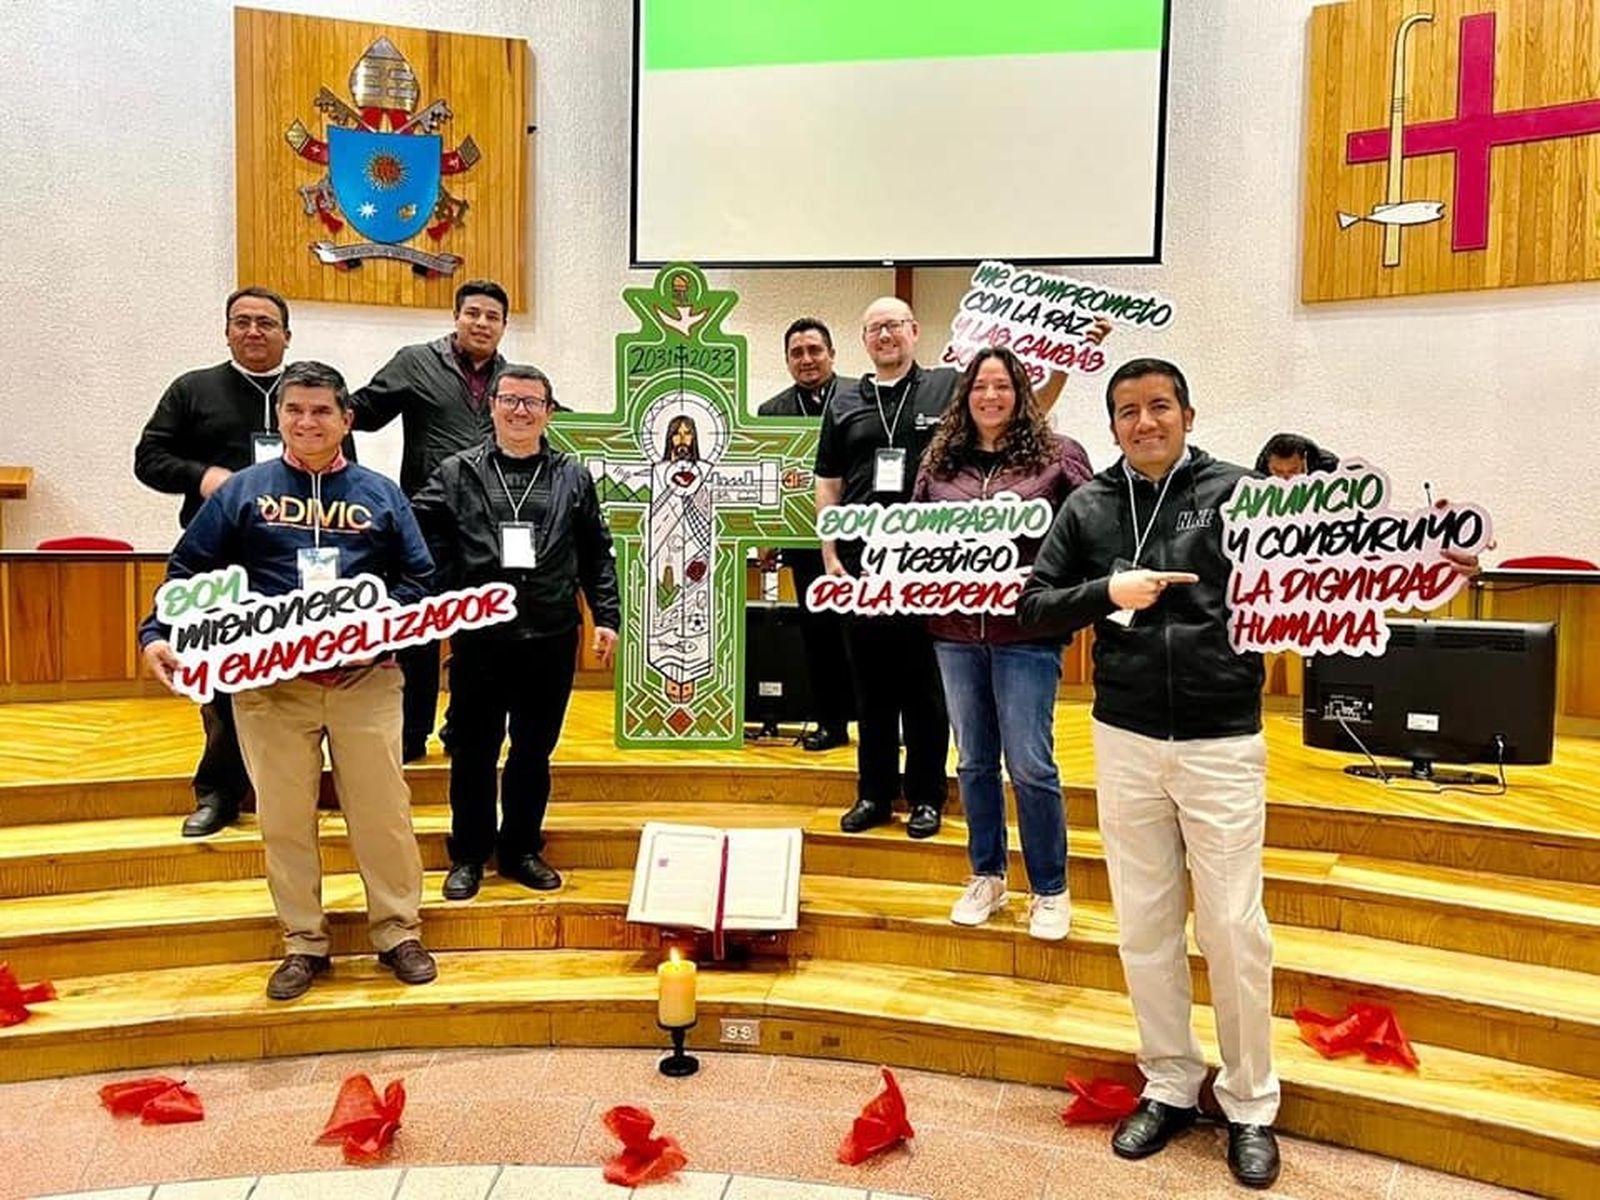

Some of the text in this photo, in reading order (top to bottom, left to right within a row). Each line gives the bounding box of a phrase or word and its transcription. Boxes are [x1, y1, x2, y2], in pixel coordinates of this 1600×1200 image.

[964, 291, 1009, 317] CON
[1010, 300, 1038, 325] LA
[974, 264, 1172, 327] ME COMPROMETO
[630, 347, 735, 375] 2031 2033
[1227, 463, 1384, 522] ANUNCIO
[819, 509, 877, 536] SOY
[1228, 508, 1483, 563] Y CONSTRUYO
[866, 538, 1014, 574] Y TESTIGO
[1232, 554, 1458, 605] LA DIGNIDAD
[163, 571, 242, 619] SOY
[811, 571, 1032, 610] DE LA REDENC
[176, 580, 379, 652] MISIONERO
[1234, 608, 1381, 648] HUMANA
[180, 588, 511, 696] Y EVANGELIZADOR
